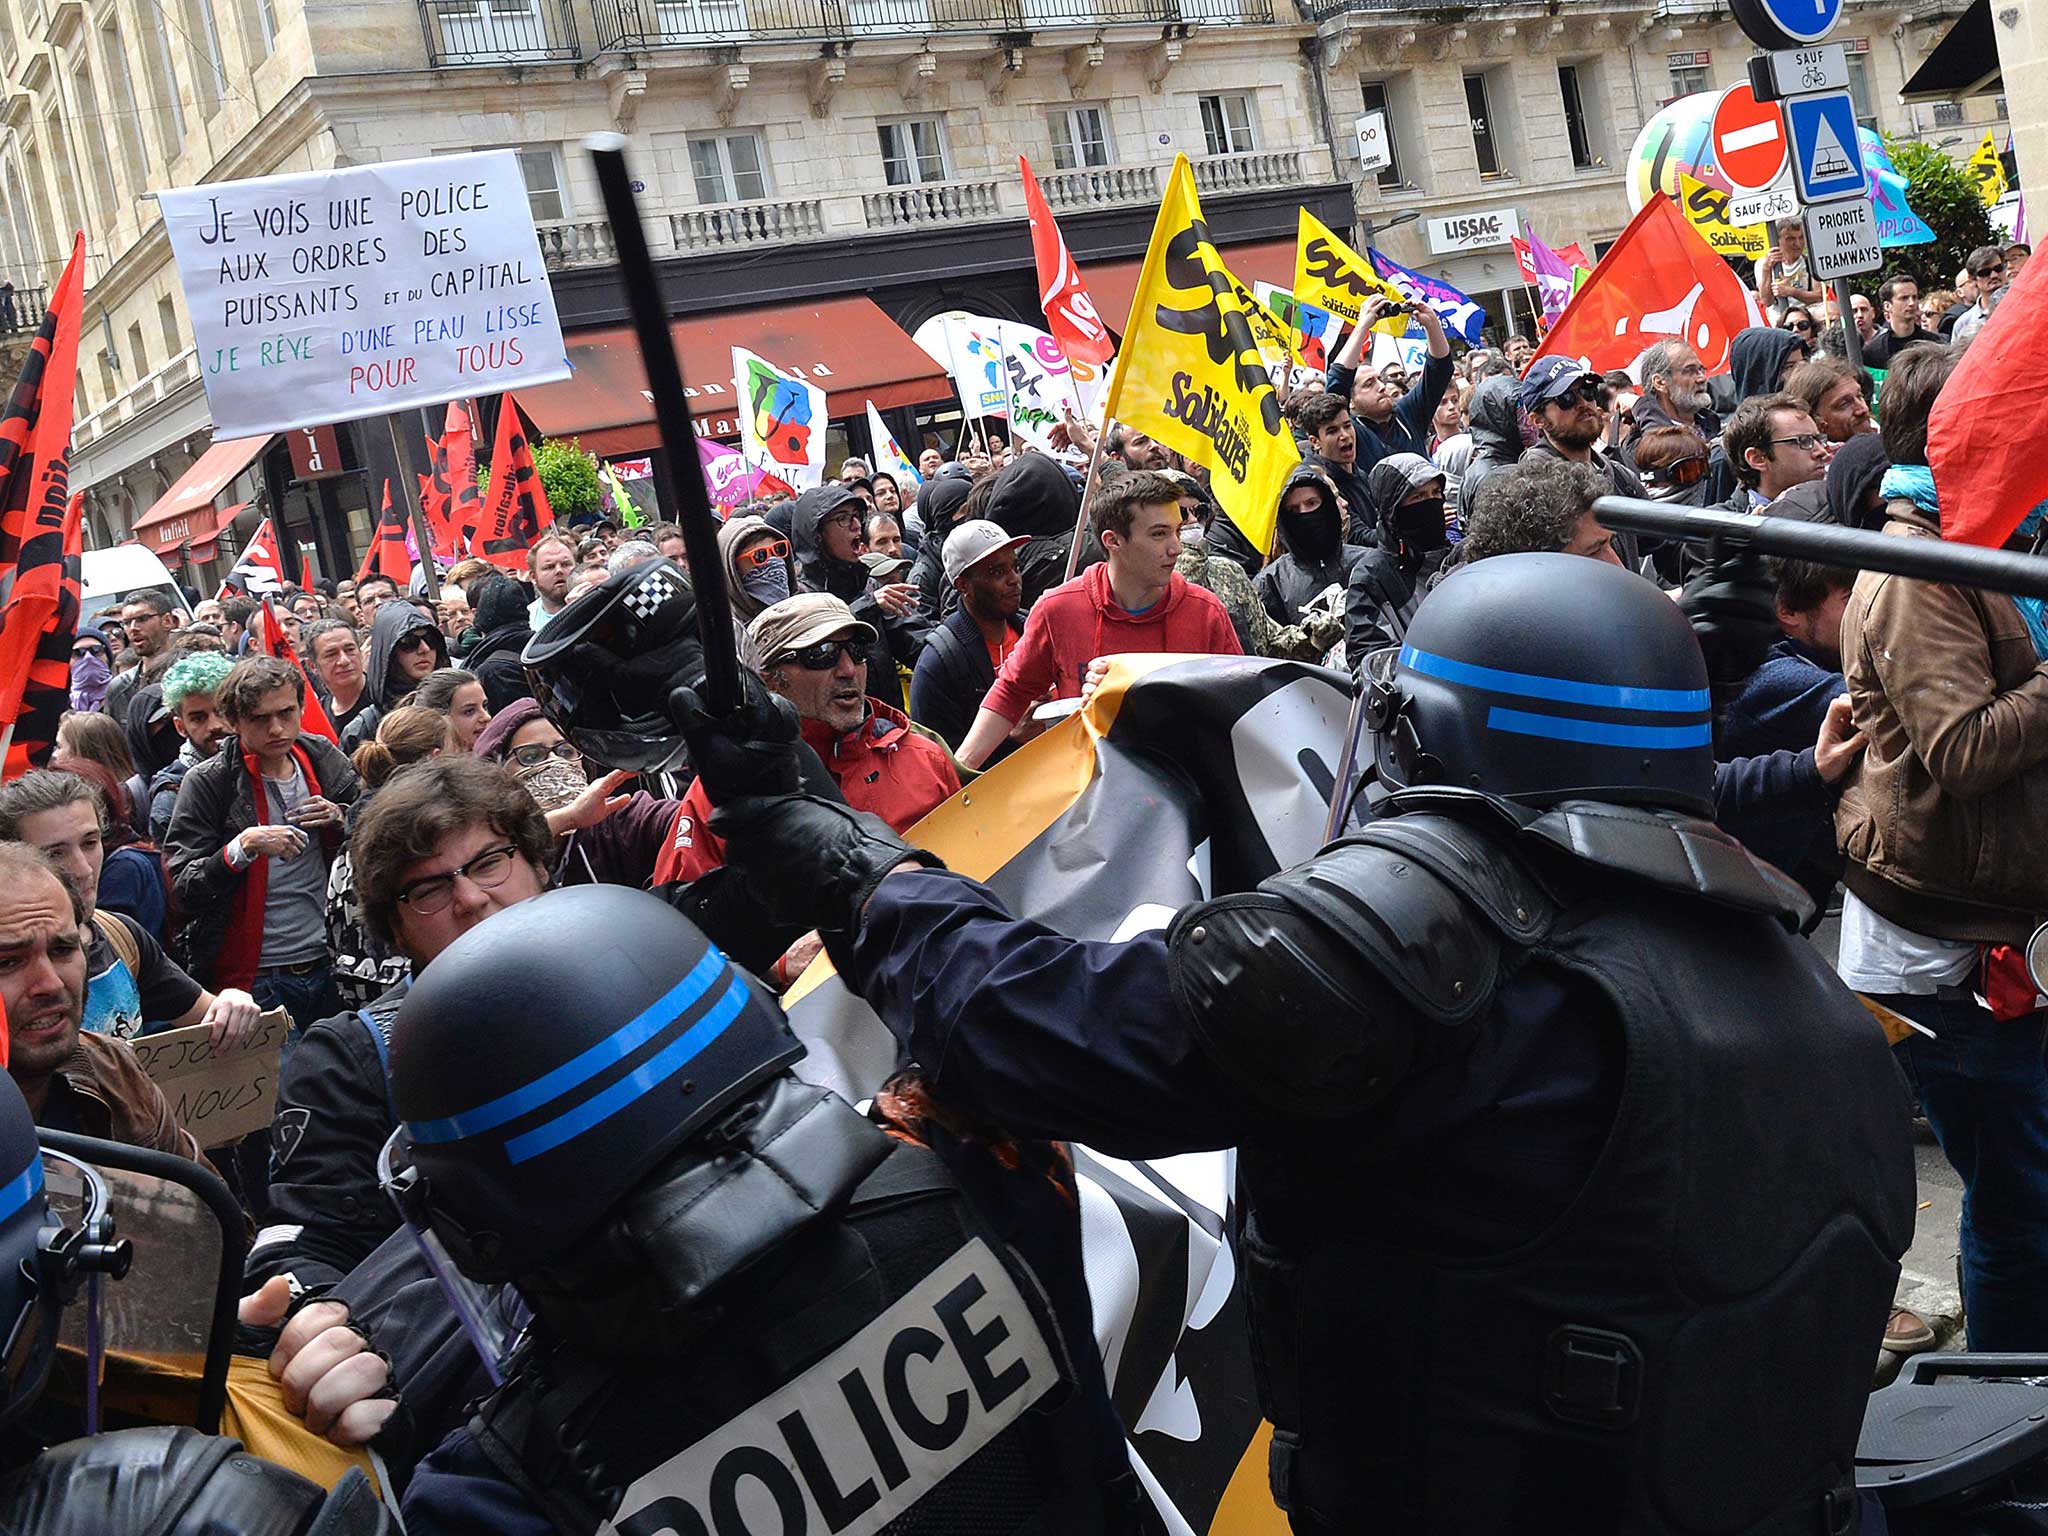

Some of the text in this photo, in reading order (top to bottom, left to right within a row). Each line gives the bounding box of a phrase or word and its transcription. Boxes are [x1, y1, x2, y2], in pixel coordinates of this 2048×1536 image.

[1796, 50, 1823, 66] SAUF
[199, 182, 489, 244] JE VOIS UNE POLICE
[1444, 215, 1499, 240] LISSAC
[1735, 203, 1762, 218] SAUF
[1818, 205, 1866, 230] PRIORITÉ
[220, 228, 467, 284] AUX ORDRES DES
[1835, 230, 1857, 248] AUX
[1818, 246, 1880, 271] TRAMWAYS
[225, 284, 358, 328] PUISSANTS
[384, 291, 400, 305] ET
[408, 289, 422, 301] DU
[209, 302, 543, 375] JE RÊVE D'UNE PEAU LISSE
[350, 337, 523, 394] POUR TOUS
[174, 1076, 267, 1126] NOUS
